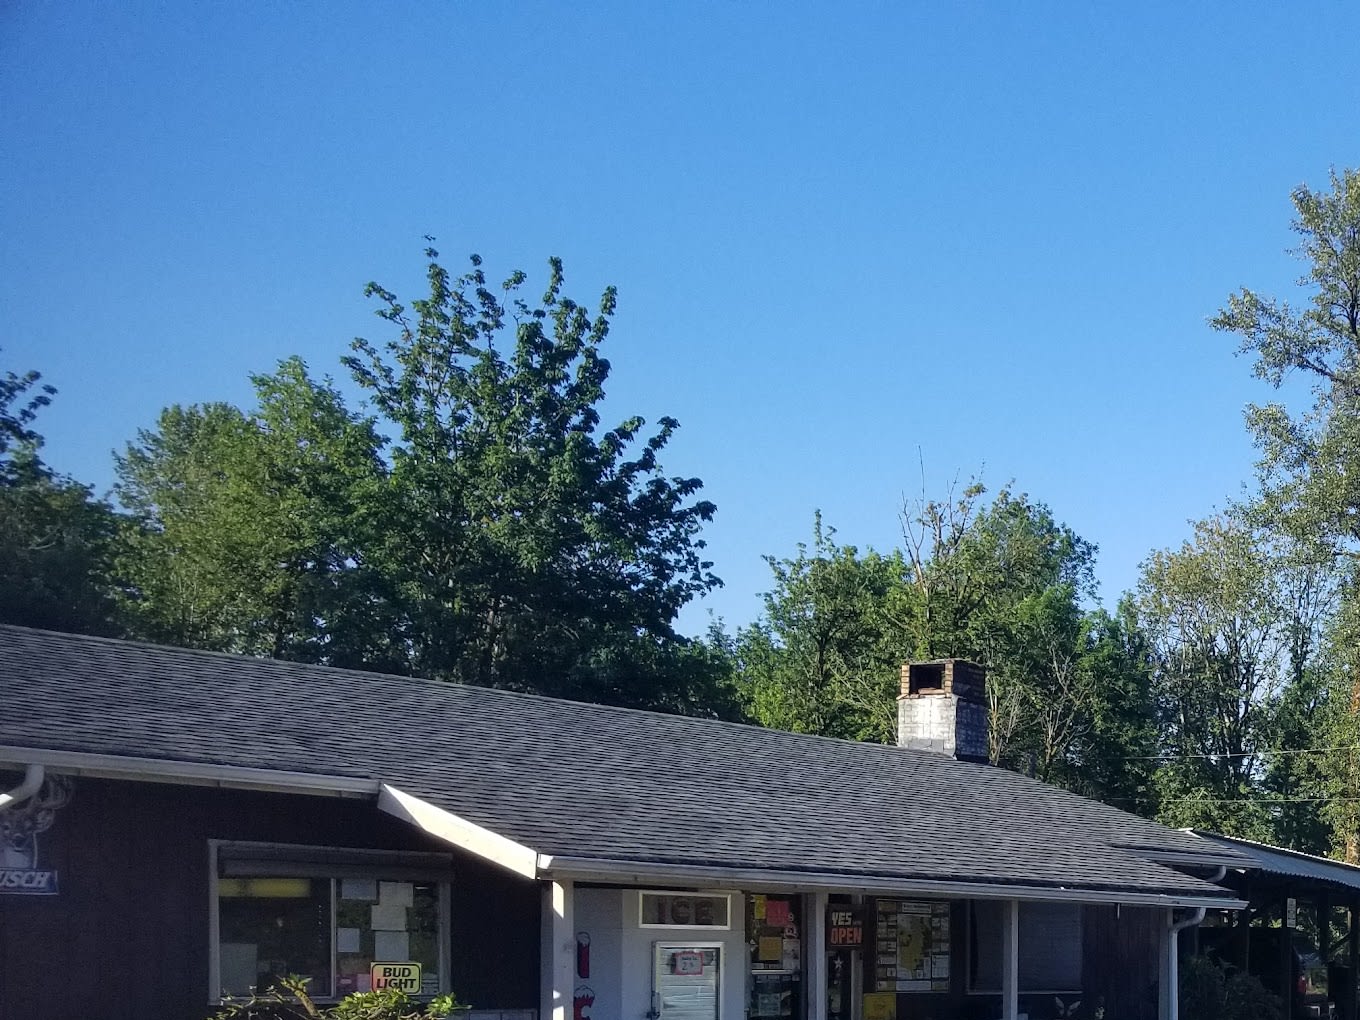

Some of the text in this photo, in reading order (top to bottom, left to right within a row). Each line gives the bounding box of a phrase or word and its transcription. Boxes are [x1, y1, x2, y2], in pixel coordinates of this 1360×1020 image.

[0, 870, 50, 887] USCH
[832, 912, 852, 926] YES
[831, 928, 863, 944] OPEN
[383, 967, 411, 978] BUD
[377, 978, 417, 989] LIGHT
